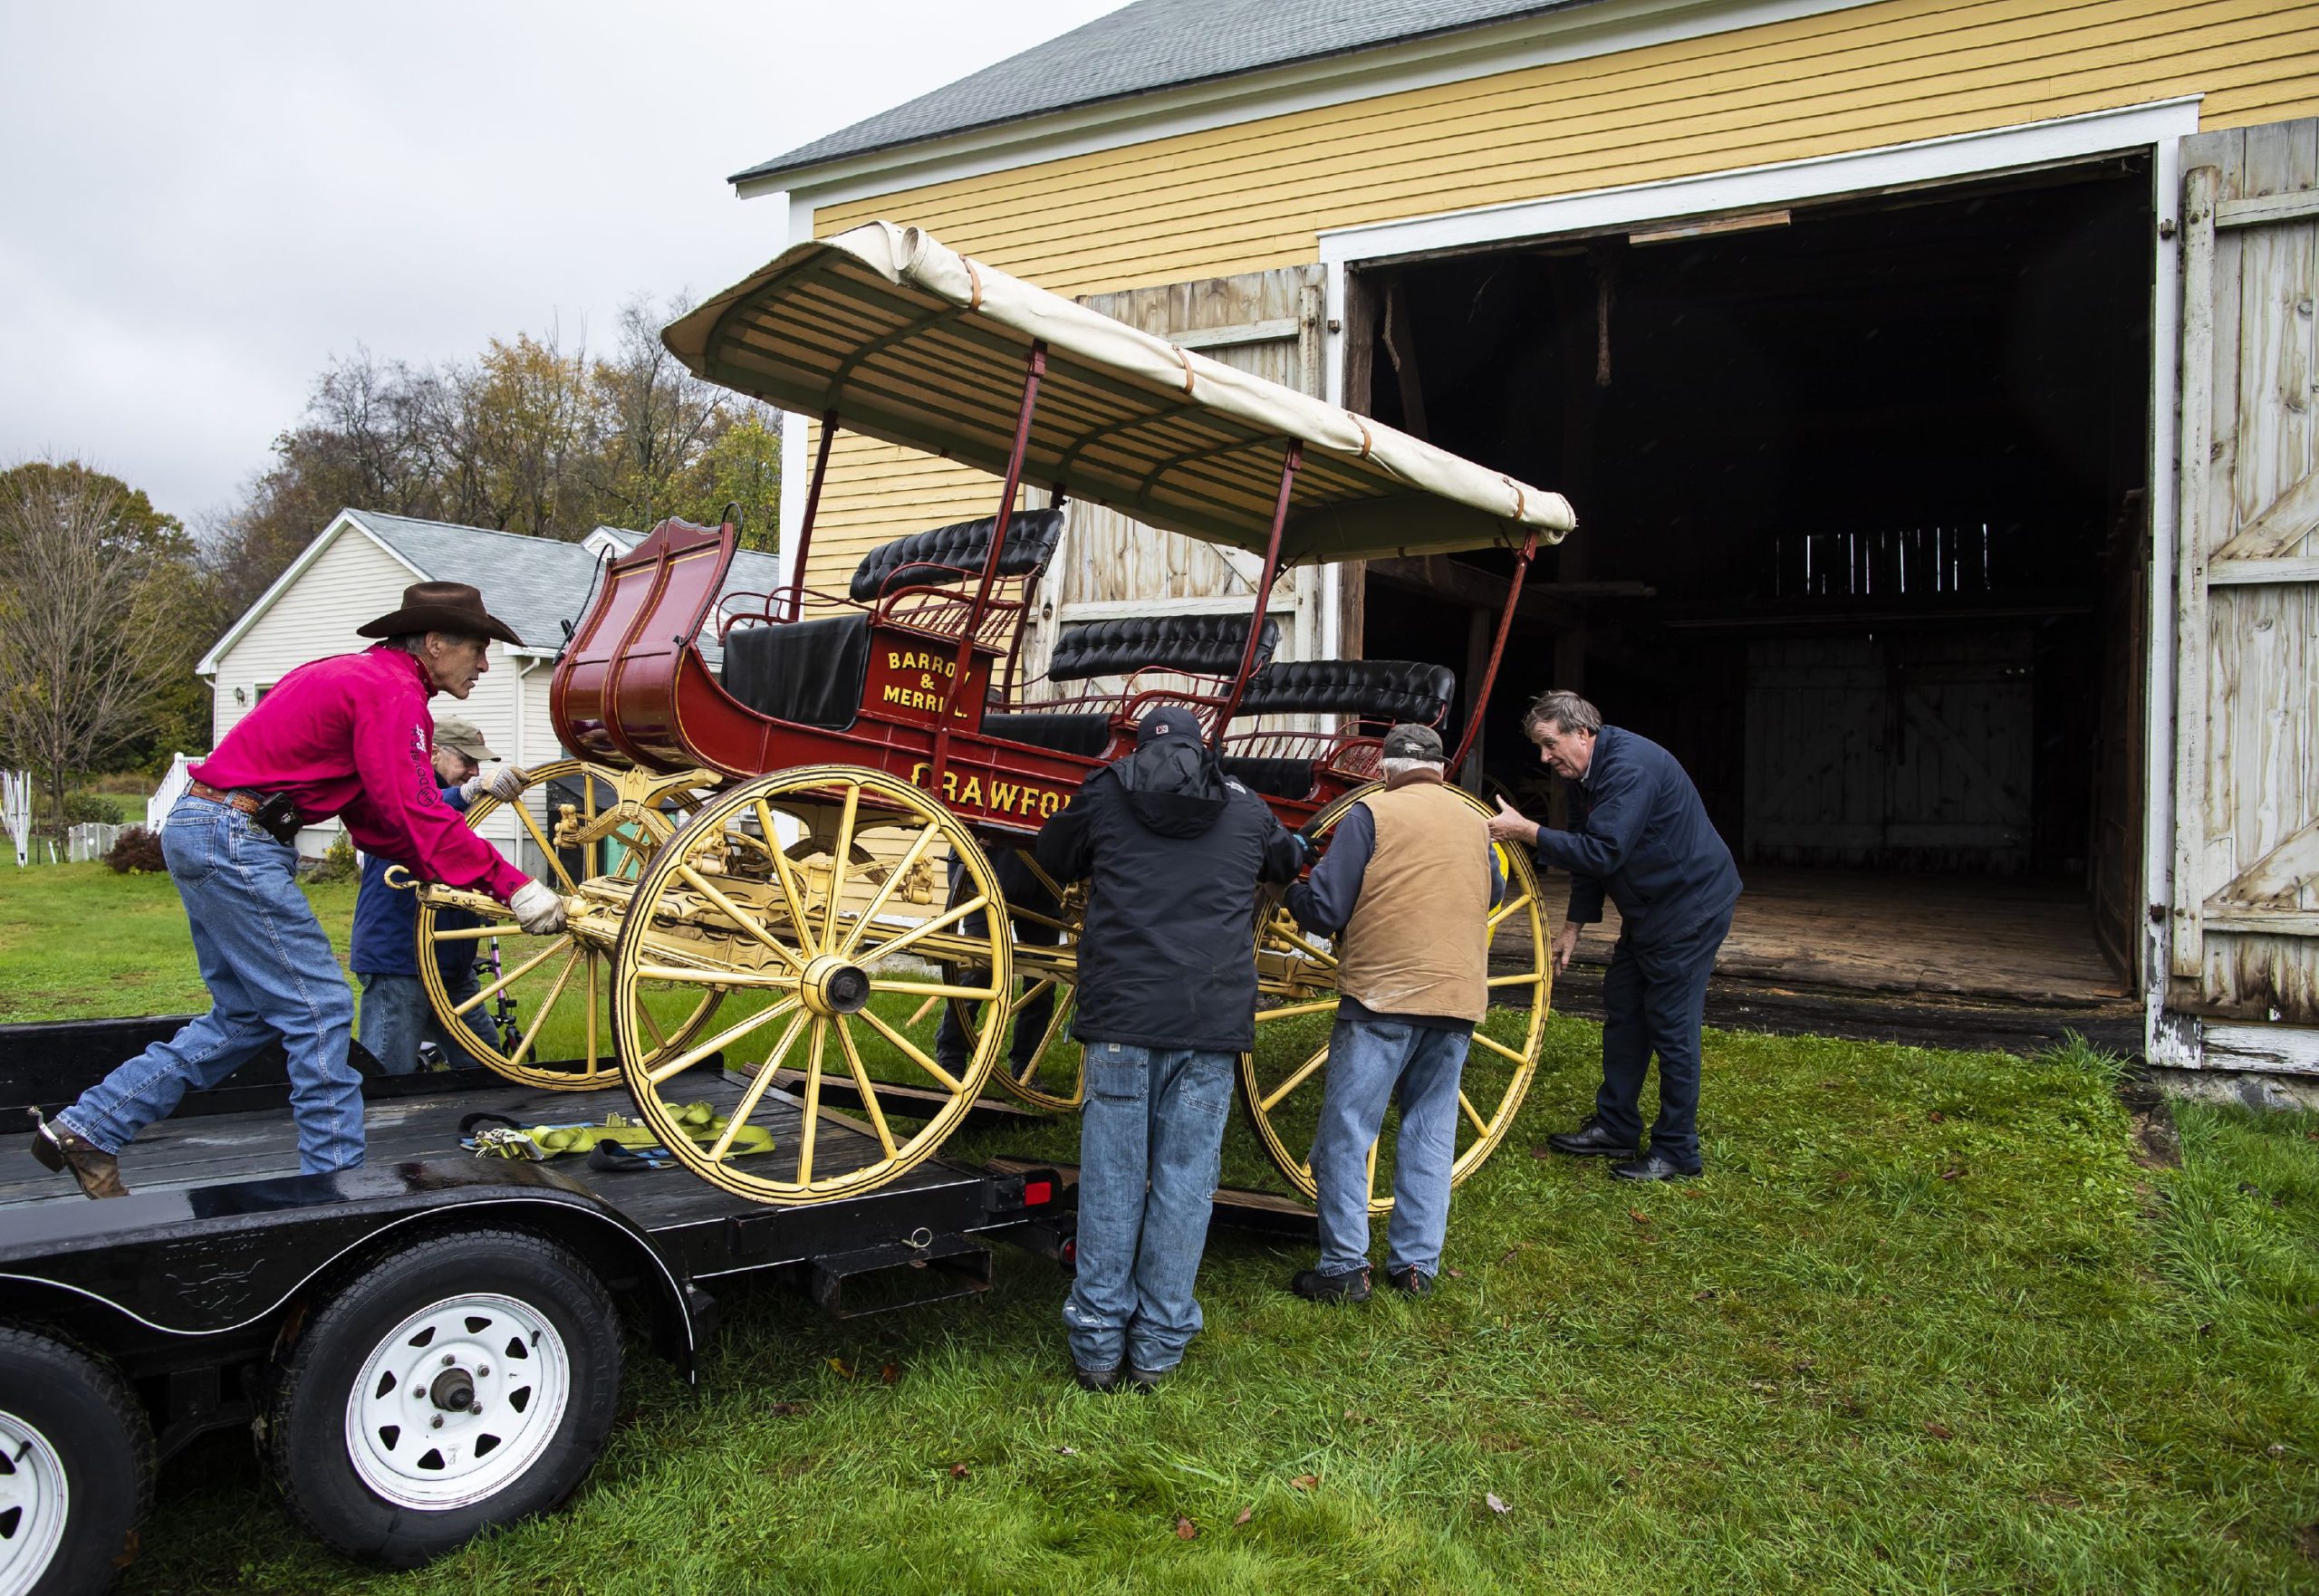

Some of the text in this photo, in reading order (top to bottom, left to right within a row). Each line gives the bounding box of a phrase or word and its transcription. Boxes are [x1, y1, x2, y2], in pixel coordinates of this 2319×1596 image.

[888, 652, 970, 684] BARRO
[920, 673, 935, 690] &
[883, 685, 967, 717] MERRIL.
[910, 762, 1071, 819] CRAWFO
